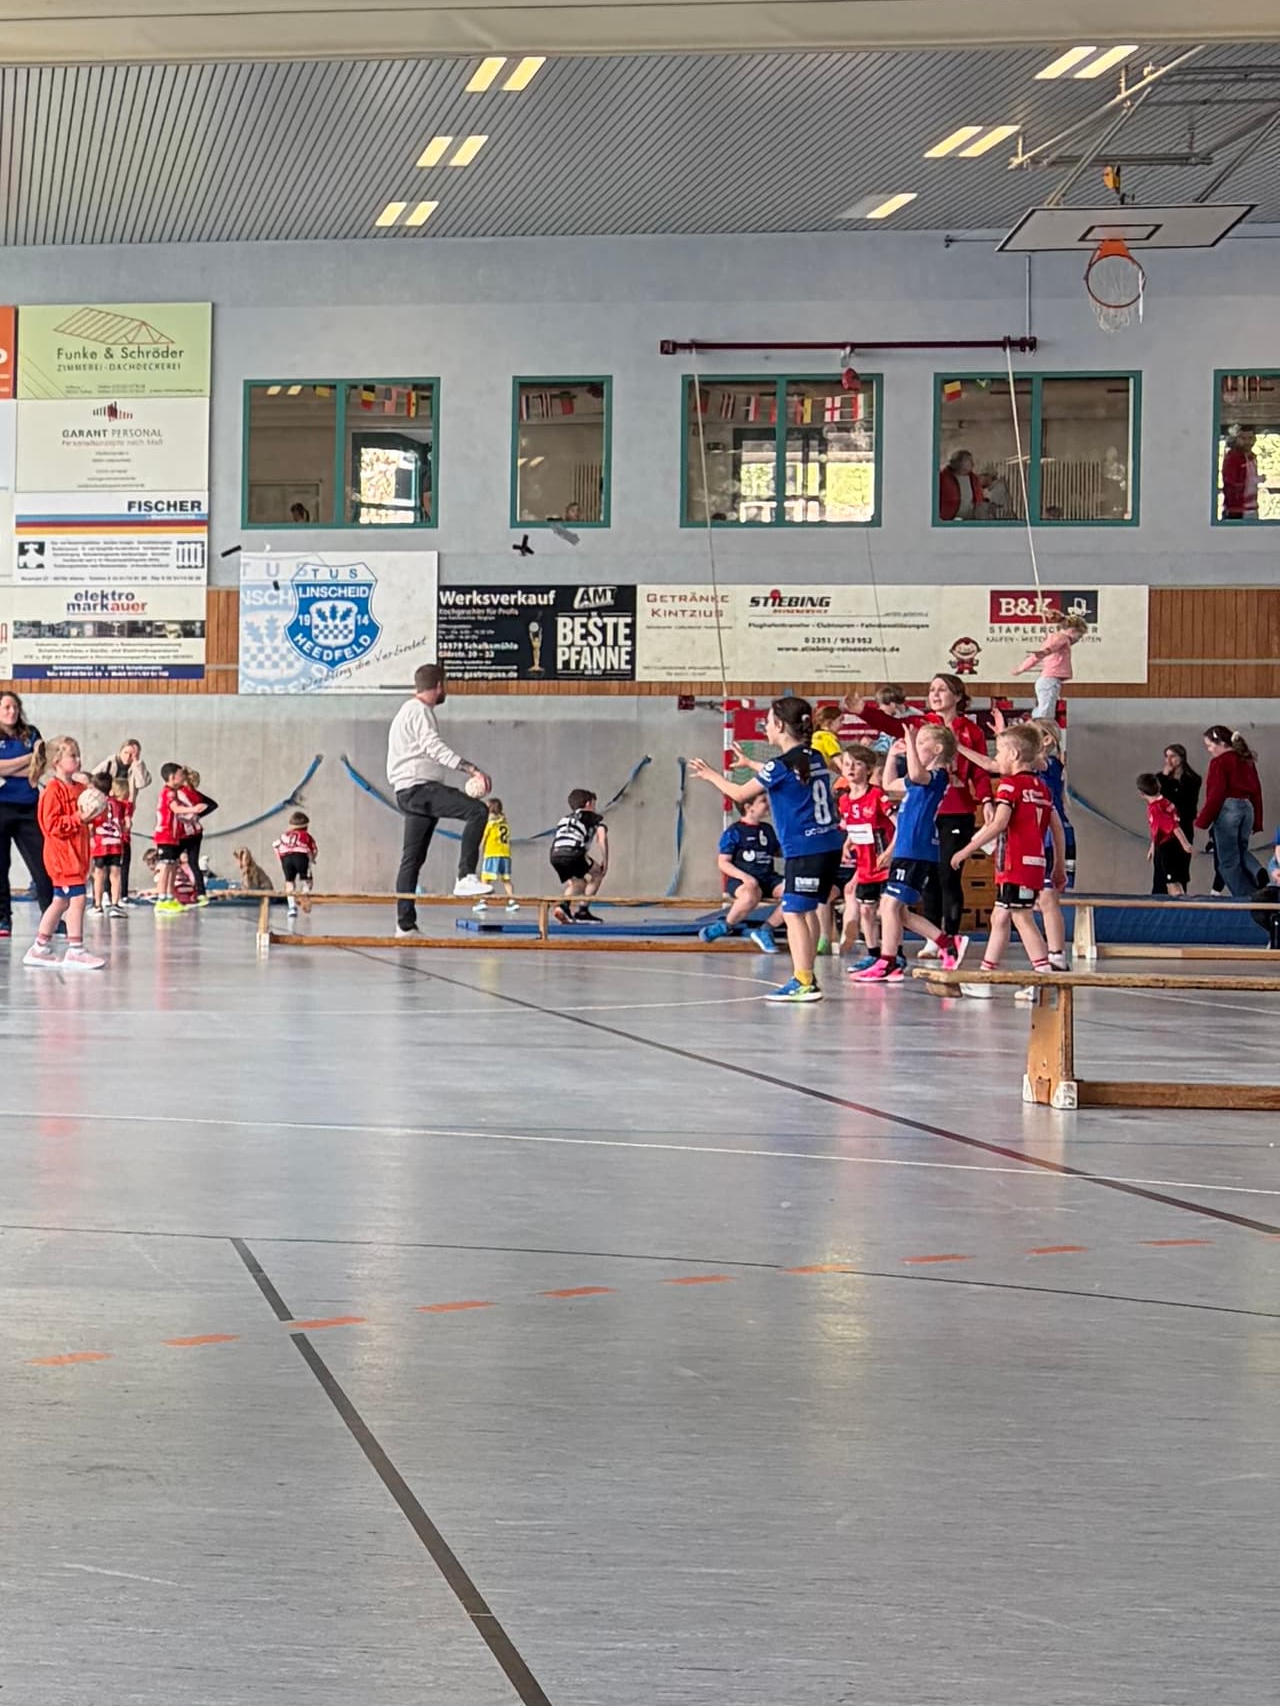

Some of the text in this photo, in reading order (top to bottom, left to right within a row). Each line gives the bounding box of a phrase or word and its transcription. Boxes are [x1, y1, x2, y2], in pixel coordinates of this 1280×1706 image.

[56, 345, 184, 360] Funke & Schröder
[62, 429, 163, 438] GARANT PERSONAL
[127, 500, 202, 512] FISCHER
[74, 590, 135, 602] elektro
[298, 586, 369, 598] LINSCHEID
[439, 589, 556, 606] Werksverkauf
[646, 592, 730, 603] GETRÄNKE
[66, 600, 147, 612] markauer
[749, 594, 831, 607] STIEBING
[999, 597, 1053, 616] B&K
[651, 608, 724, 618] KINTZIUS
[298, 614, 369, 626] 19 14
[557, 616, 632, 646] BESTE
[989, 626, 1099, 634] STAPLERCER
[293, 633, 371, 662] HEEDFELD
[464, 641, 519, 650] Schalksmühle
[557, 646, 632, 670] PFANNE
[356, 659, 372, 670] die
[812, 779, 832, 826] 8
